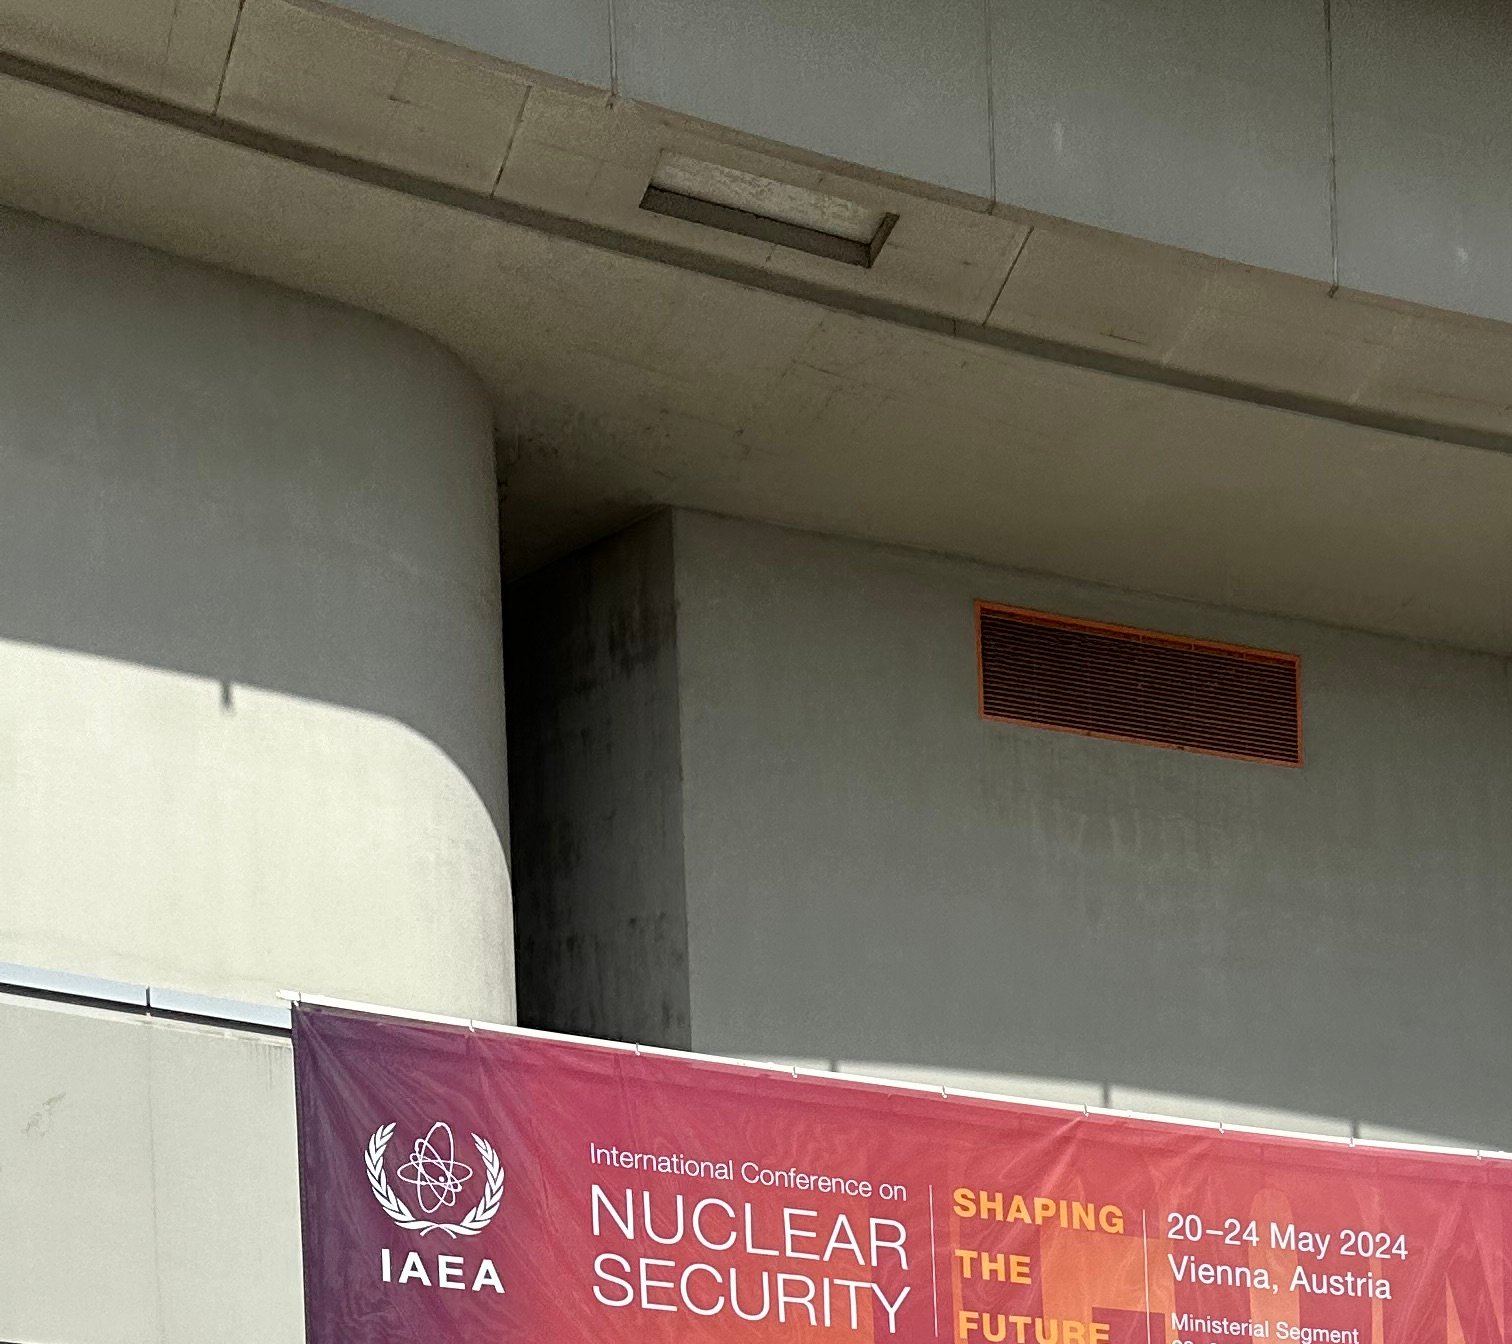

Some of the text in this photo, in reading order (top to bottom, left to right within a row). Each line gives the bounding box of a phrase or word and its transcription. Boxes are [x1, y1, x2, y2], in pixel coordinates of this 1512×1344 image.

[590, 1142, 908, 1201] International Conference on
[591, 1184, 909, 1270] NUCLEAR
[953, 1187, 1125, 1234] SHAPING
[1270, 1222, 1331, 1260] May
[1339, 1229, 1408, 1260] 2024
[381, 1248, 506, 1294] IAEA
[955, 1249, 1032, 1285] THE
[1168, 1254, 1392, 1300] Vienna, Austria
[592, 1252, 911, 1334] SECURITY
[1171, 1312, 1269, 1338] Ministerial
